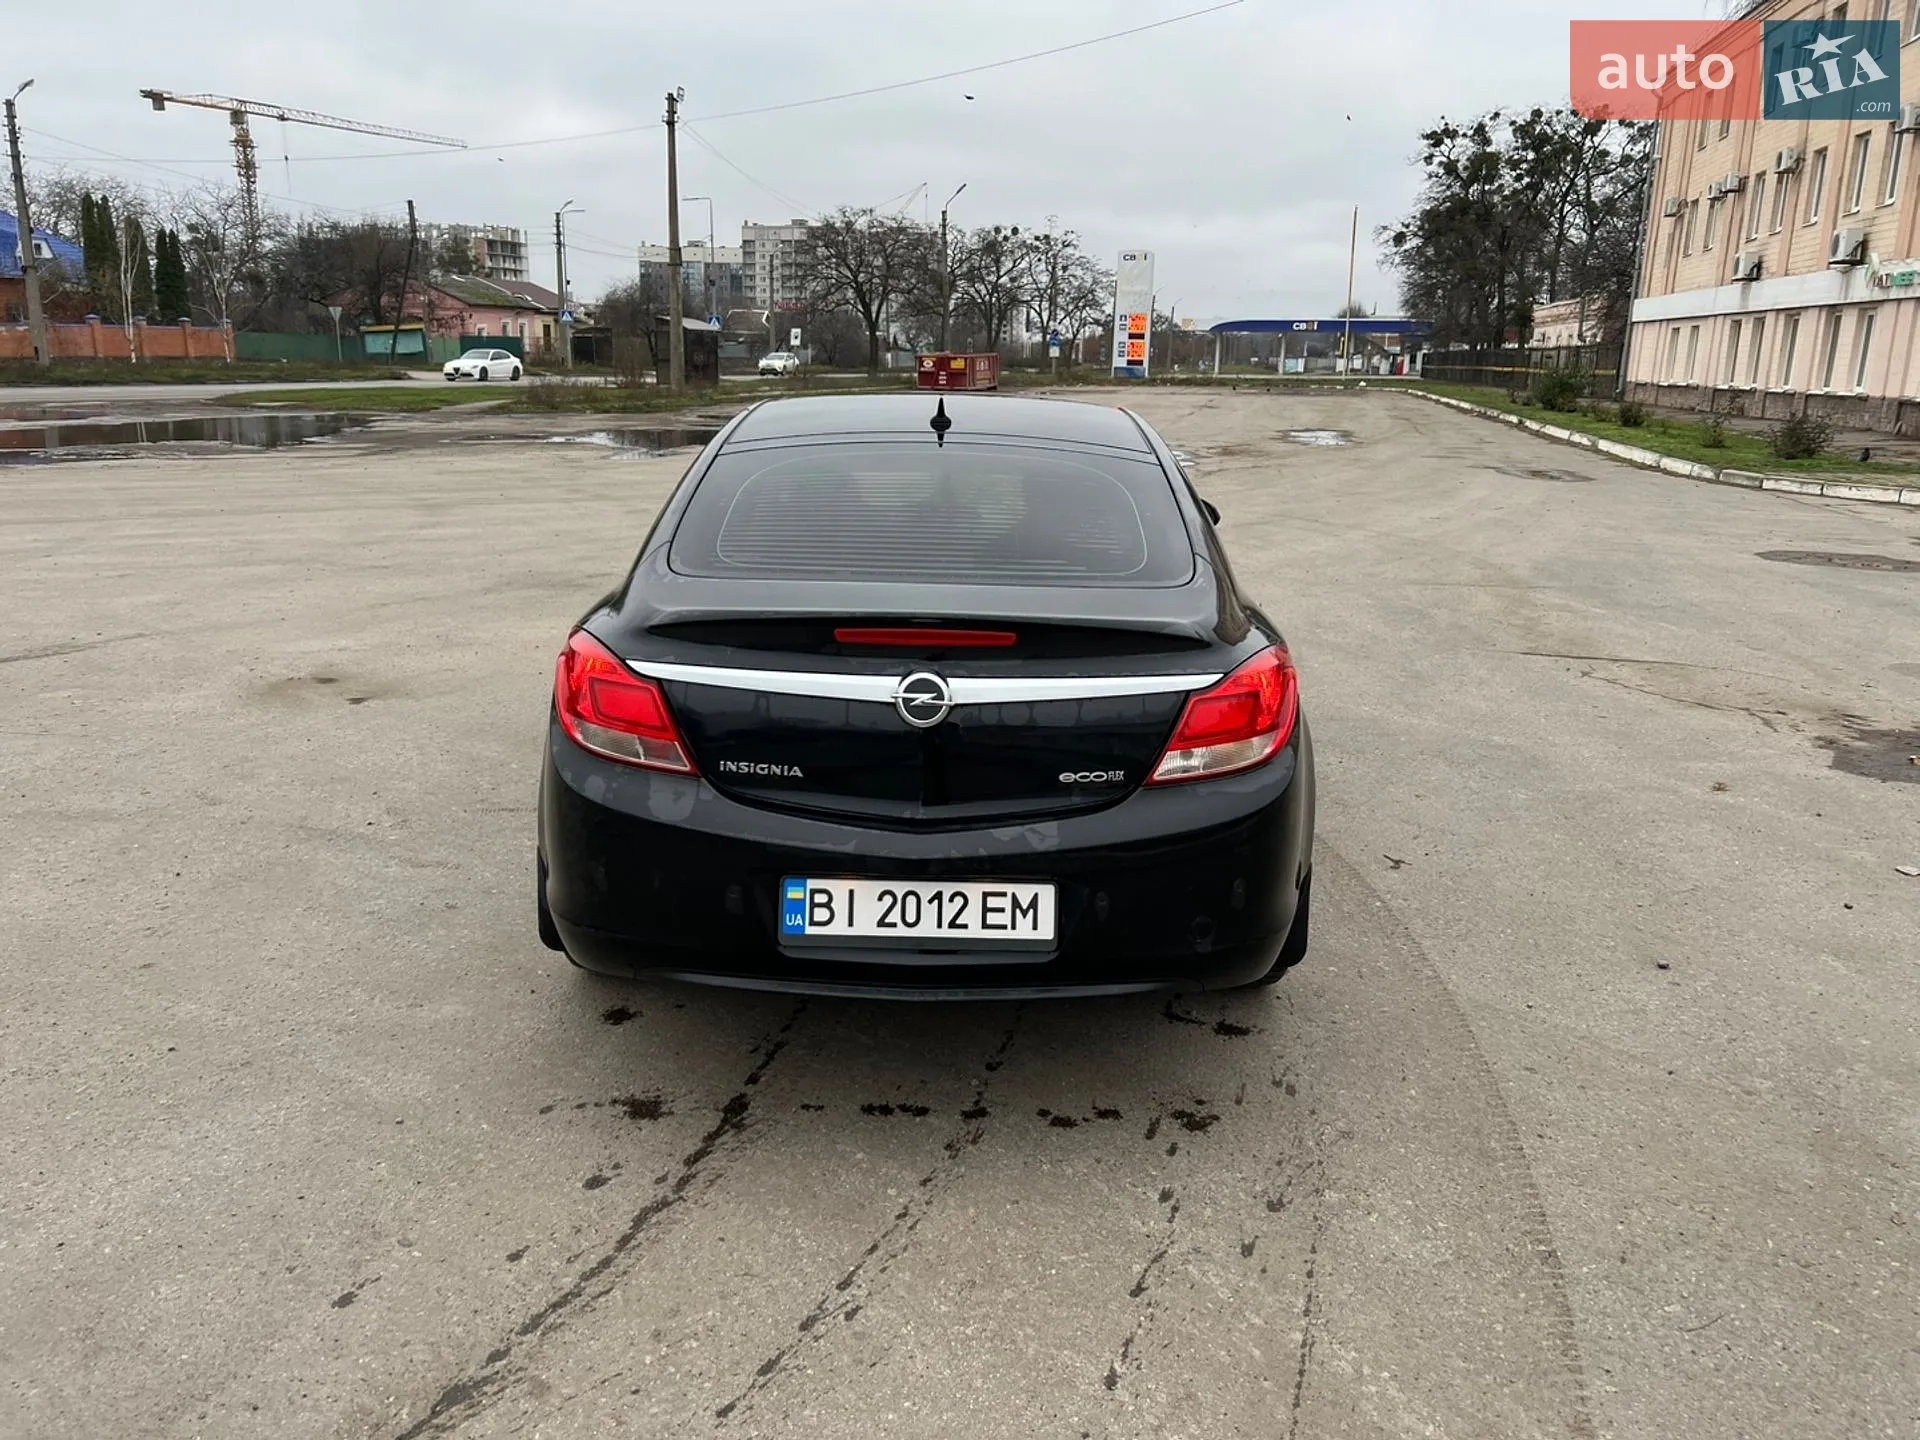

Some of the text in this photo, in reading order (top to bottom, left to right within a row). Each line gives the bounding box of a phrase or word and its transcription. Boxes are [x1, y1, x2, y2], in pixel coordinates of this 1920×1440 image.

[719, 760, 804, 778] INSIGNIA
[808, 888, 1039, 931] BI 2012 EM
[785, 912, 804, 927] UA
